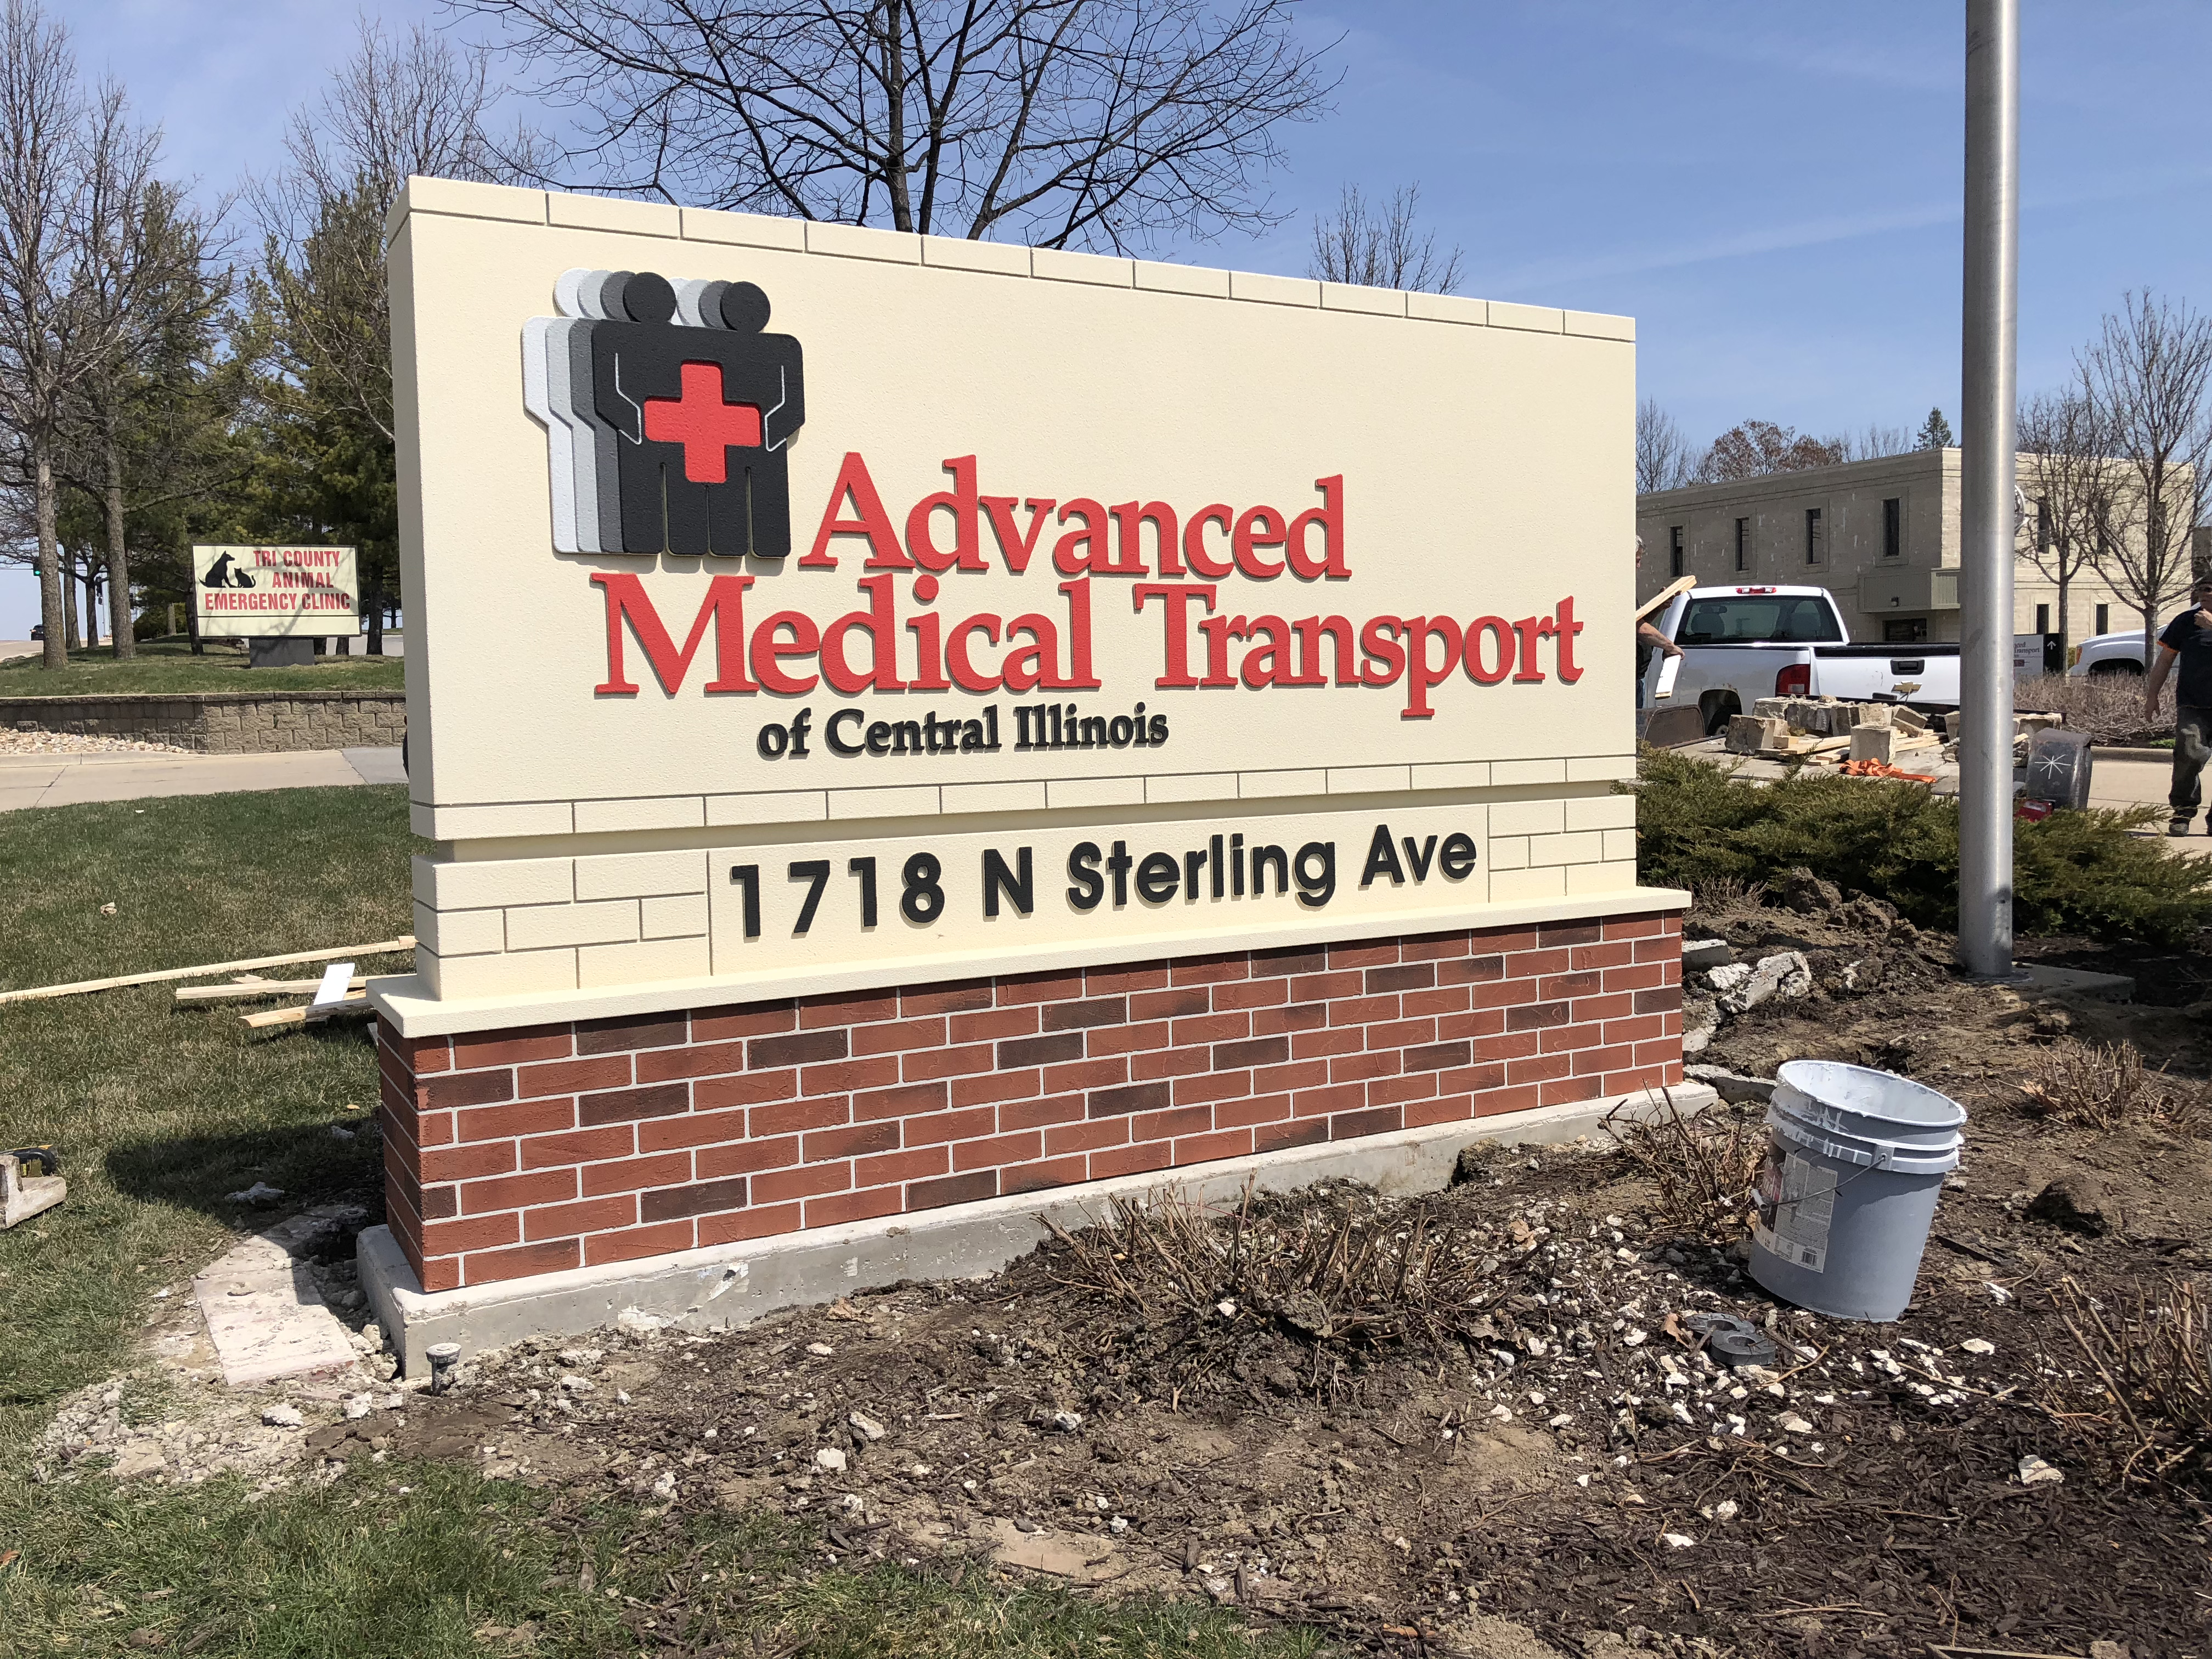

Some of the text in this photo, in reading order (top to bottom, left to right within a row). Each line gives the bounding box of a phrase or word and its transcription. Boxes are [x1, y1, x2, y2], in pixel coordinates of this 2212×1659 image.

[799, 451, 1353, 579] Advanced
[253, 550, 340, 567] TRI COUNTY
[272, 572, 334, 589] ANIMAL
[205, 593, 351, 611] EMERGENCY CLINIC
[590, 572, 1585, 718] Medical Transport
[758, 702, 1169, 758] of Central Illinois
[731, 823, 1477, 938] 1718 N Sterling Ave
